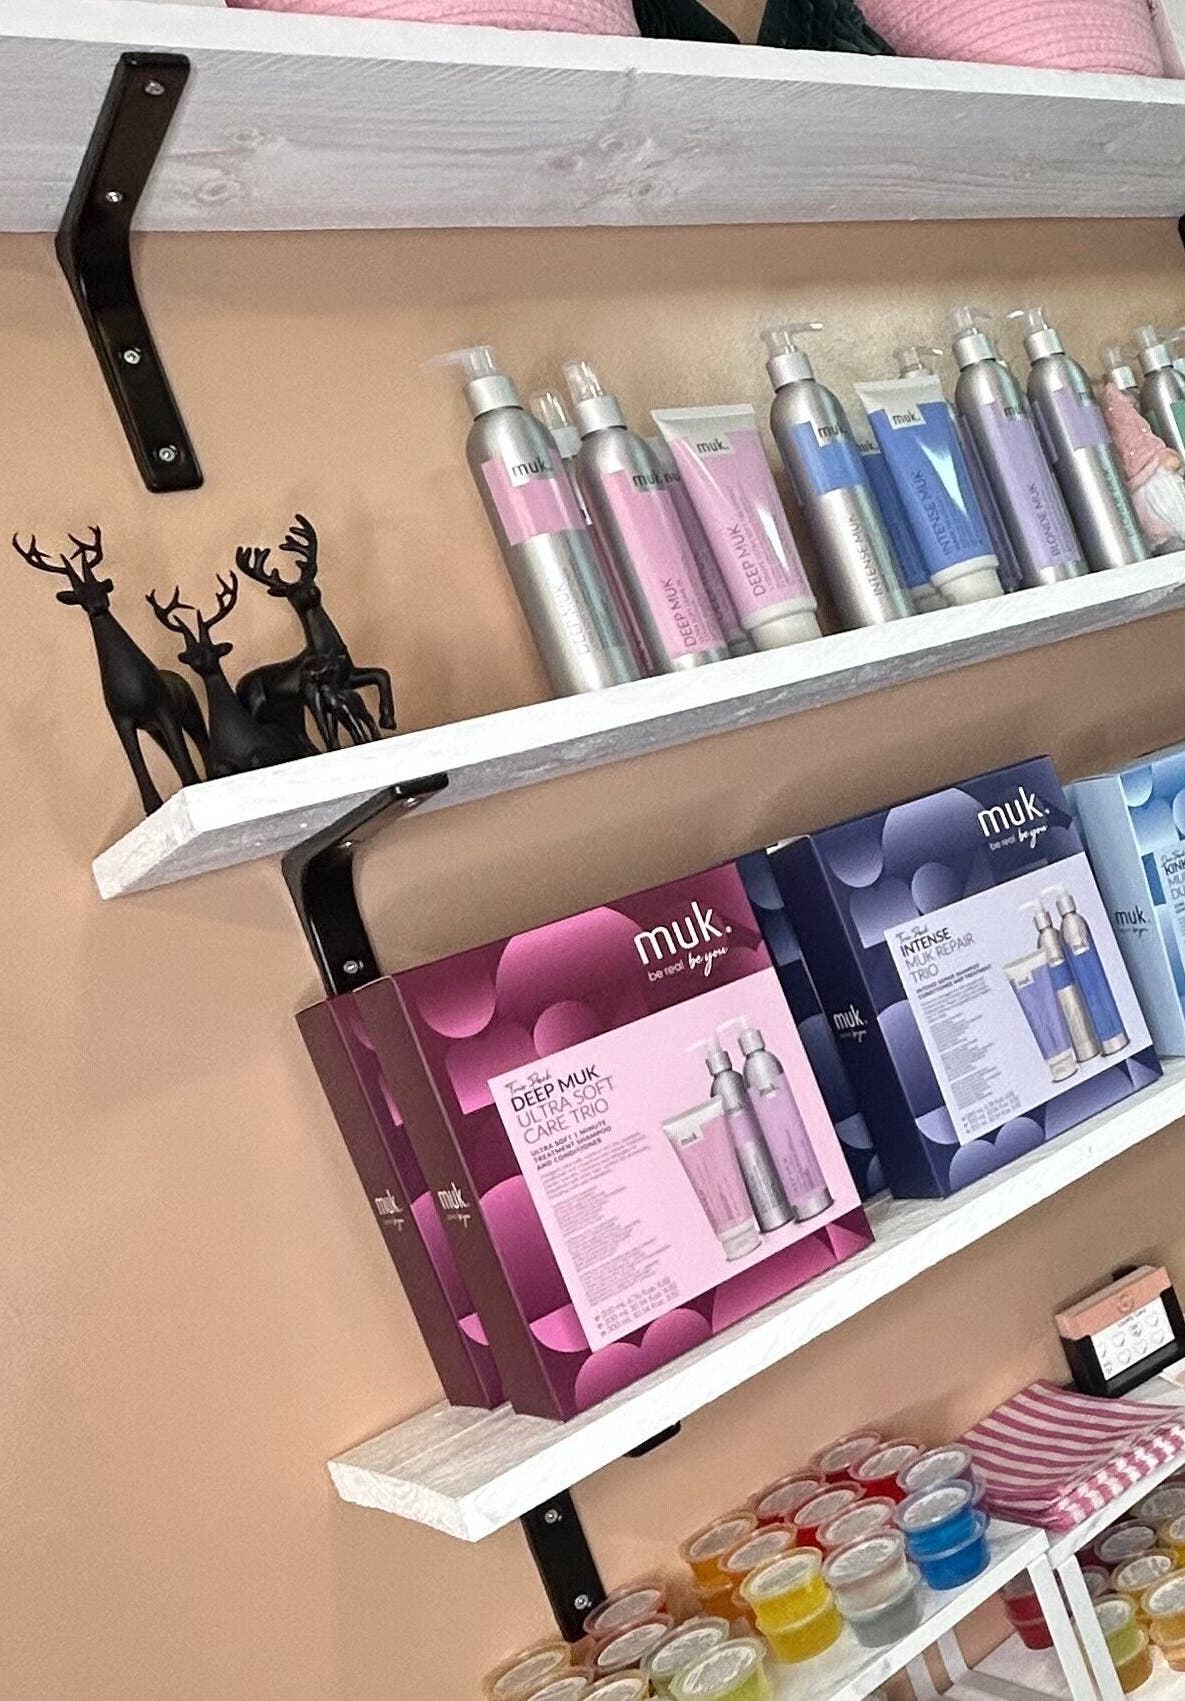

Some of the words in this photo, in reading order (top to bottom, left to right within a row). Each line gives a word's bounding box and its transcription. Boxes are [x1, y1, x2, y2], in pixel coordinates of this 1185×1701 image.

[727, 523, 750, 559] MUK
[661, 578, 682, 611] MUK
[742, 560, 766, 597] DEEP
[673, 613, 697, 647] DEEP
[978, 786, 1050, 837] muk.
[633, 901, 732, 965] muk.
[900, 927, 952, 958] INTENSE
[905, 949, 935, 970] MUK
[935, 933, 976, 958] REPAIR
[648, 970, 664, 981] be
[664, 960, 684, 976] real
[909, 963, 939, 984] TRIO
[511, 1083, 554, 1112] DEEP
[557, 1064, 600, 1092] MUK
[517, 1096, 573, 1128] ULTRA
[572, 1075, 614, 1104] SOFT
[523, 1114, 569, 1145] CARE
[569, 1098, 609, 1124] TRIO
